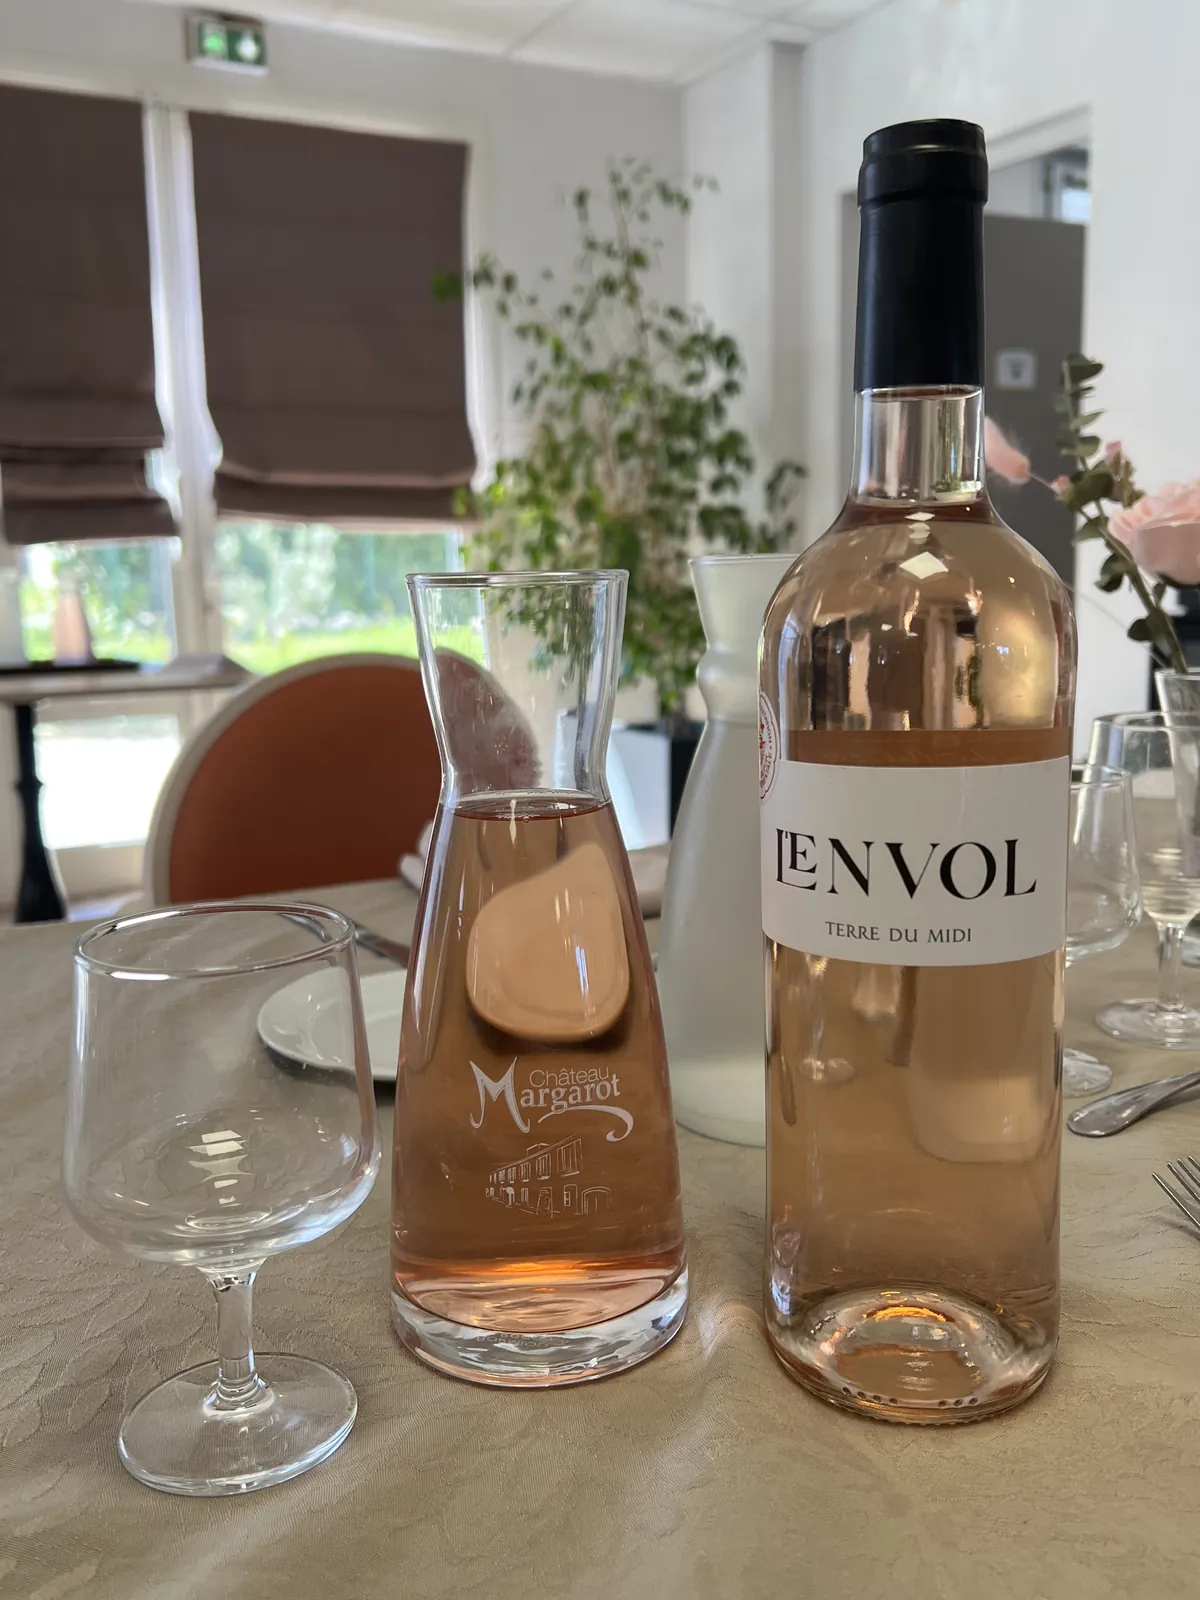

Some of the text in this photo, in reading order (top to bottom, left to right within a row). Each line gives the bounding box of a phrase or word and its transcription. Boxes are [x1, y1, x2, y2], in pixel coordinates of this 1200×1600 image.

[776, 828, 1037, 900] L'ENVOL
[825, 921, 972, 943] TERRE DU MIDI
[469, 1056, 633, 1141] Margarot
[529, 1066, 609, 1088] Château
